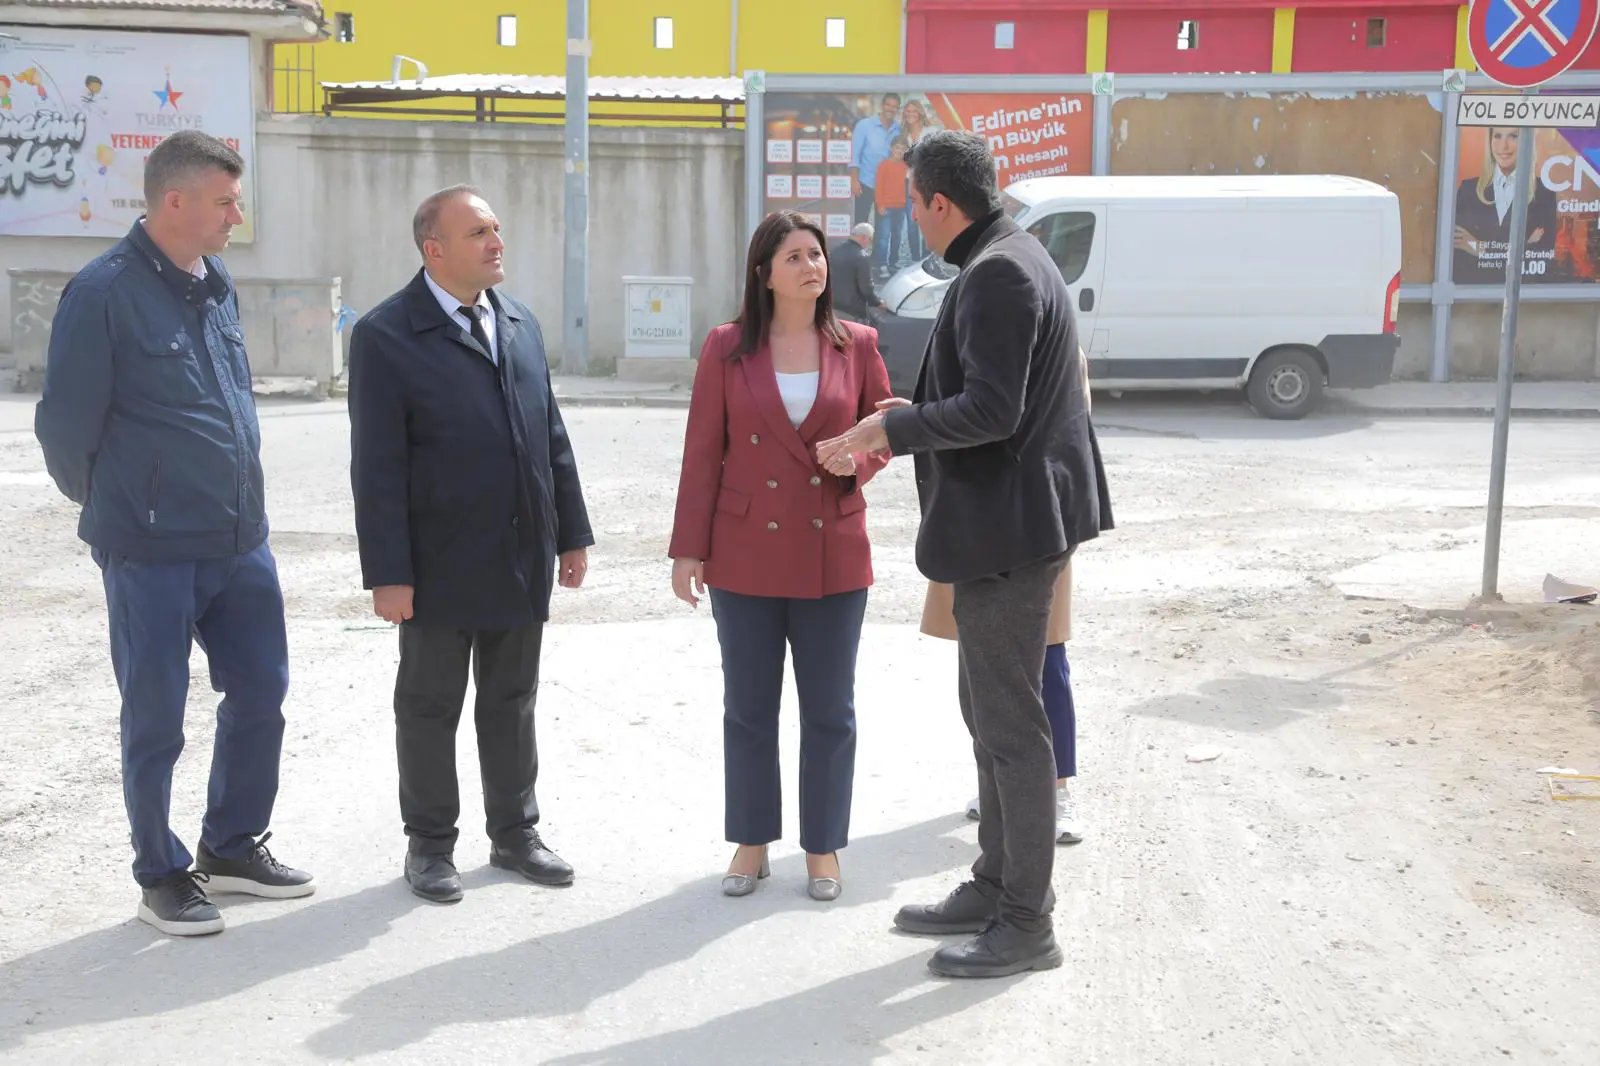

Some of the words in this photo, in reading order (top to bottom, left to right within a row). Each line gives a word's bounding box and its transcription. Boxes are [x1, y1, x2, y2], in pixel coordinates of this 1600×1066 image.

[971, 96, 1082, 133] Edirne'nin
[1463, 101, 1497, 119] YOL
[1503, 101, 1596, 120] BOYUNCA
[1005, 121, 1068, 147] Büyük
[1014, 145, 1069, 166] Hesaplı
[1557, 198, 1600, 213] Günd
